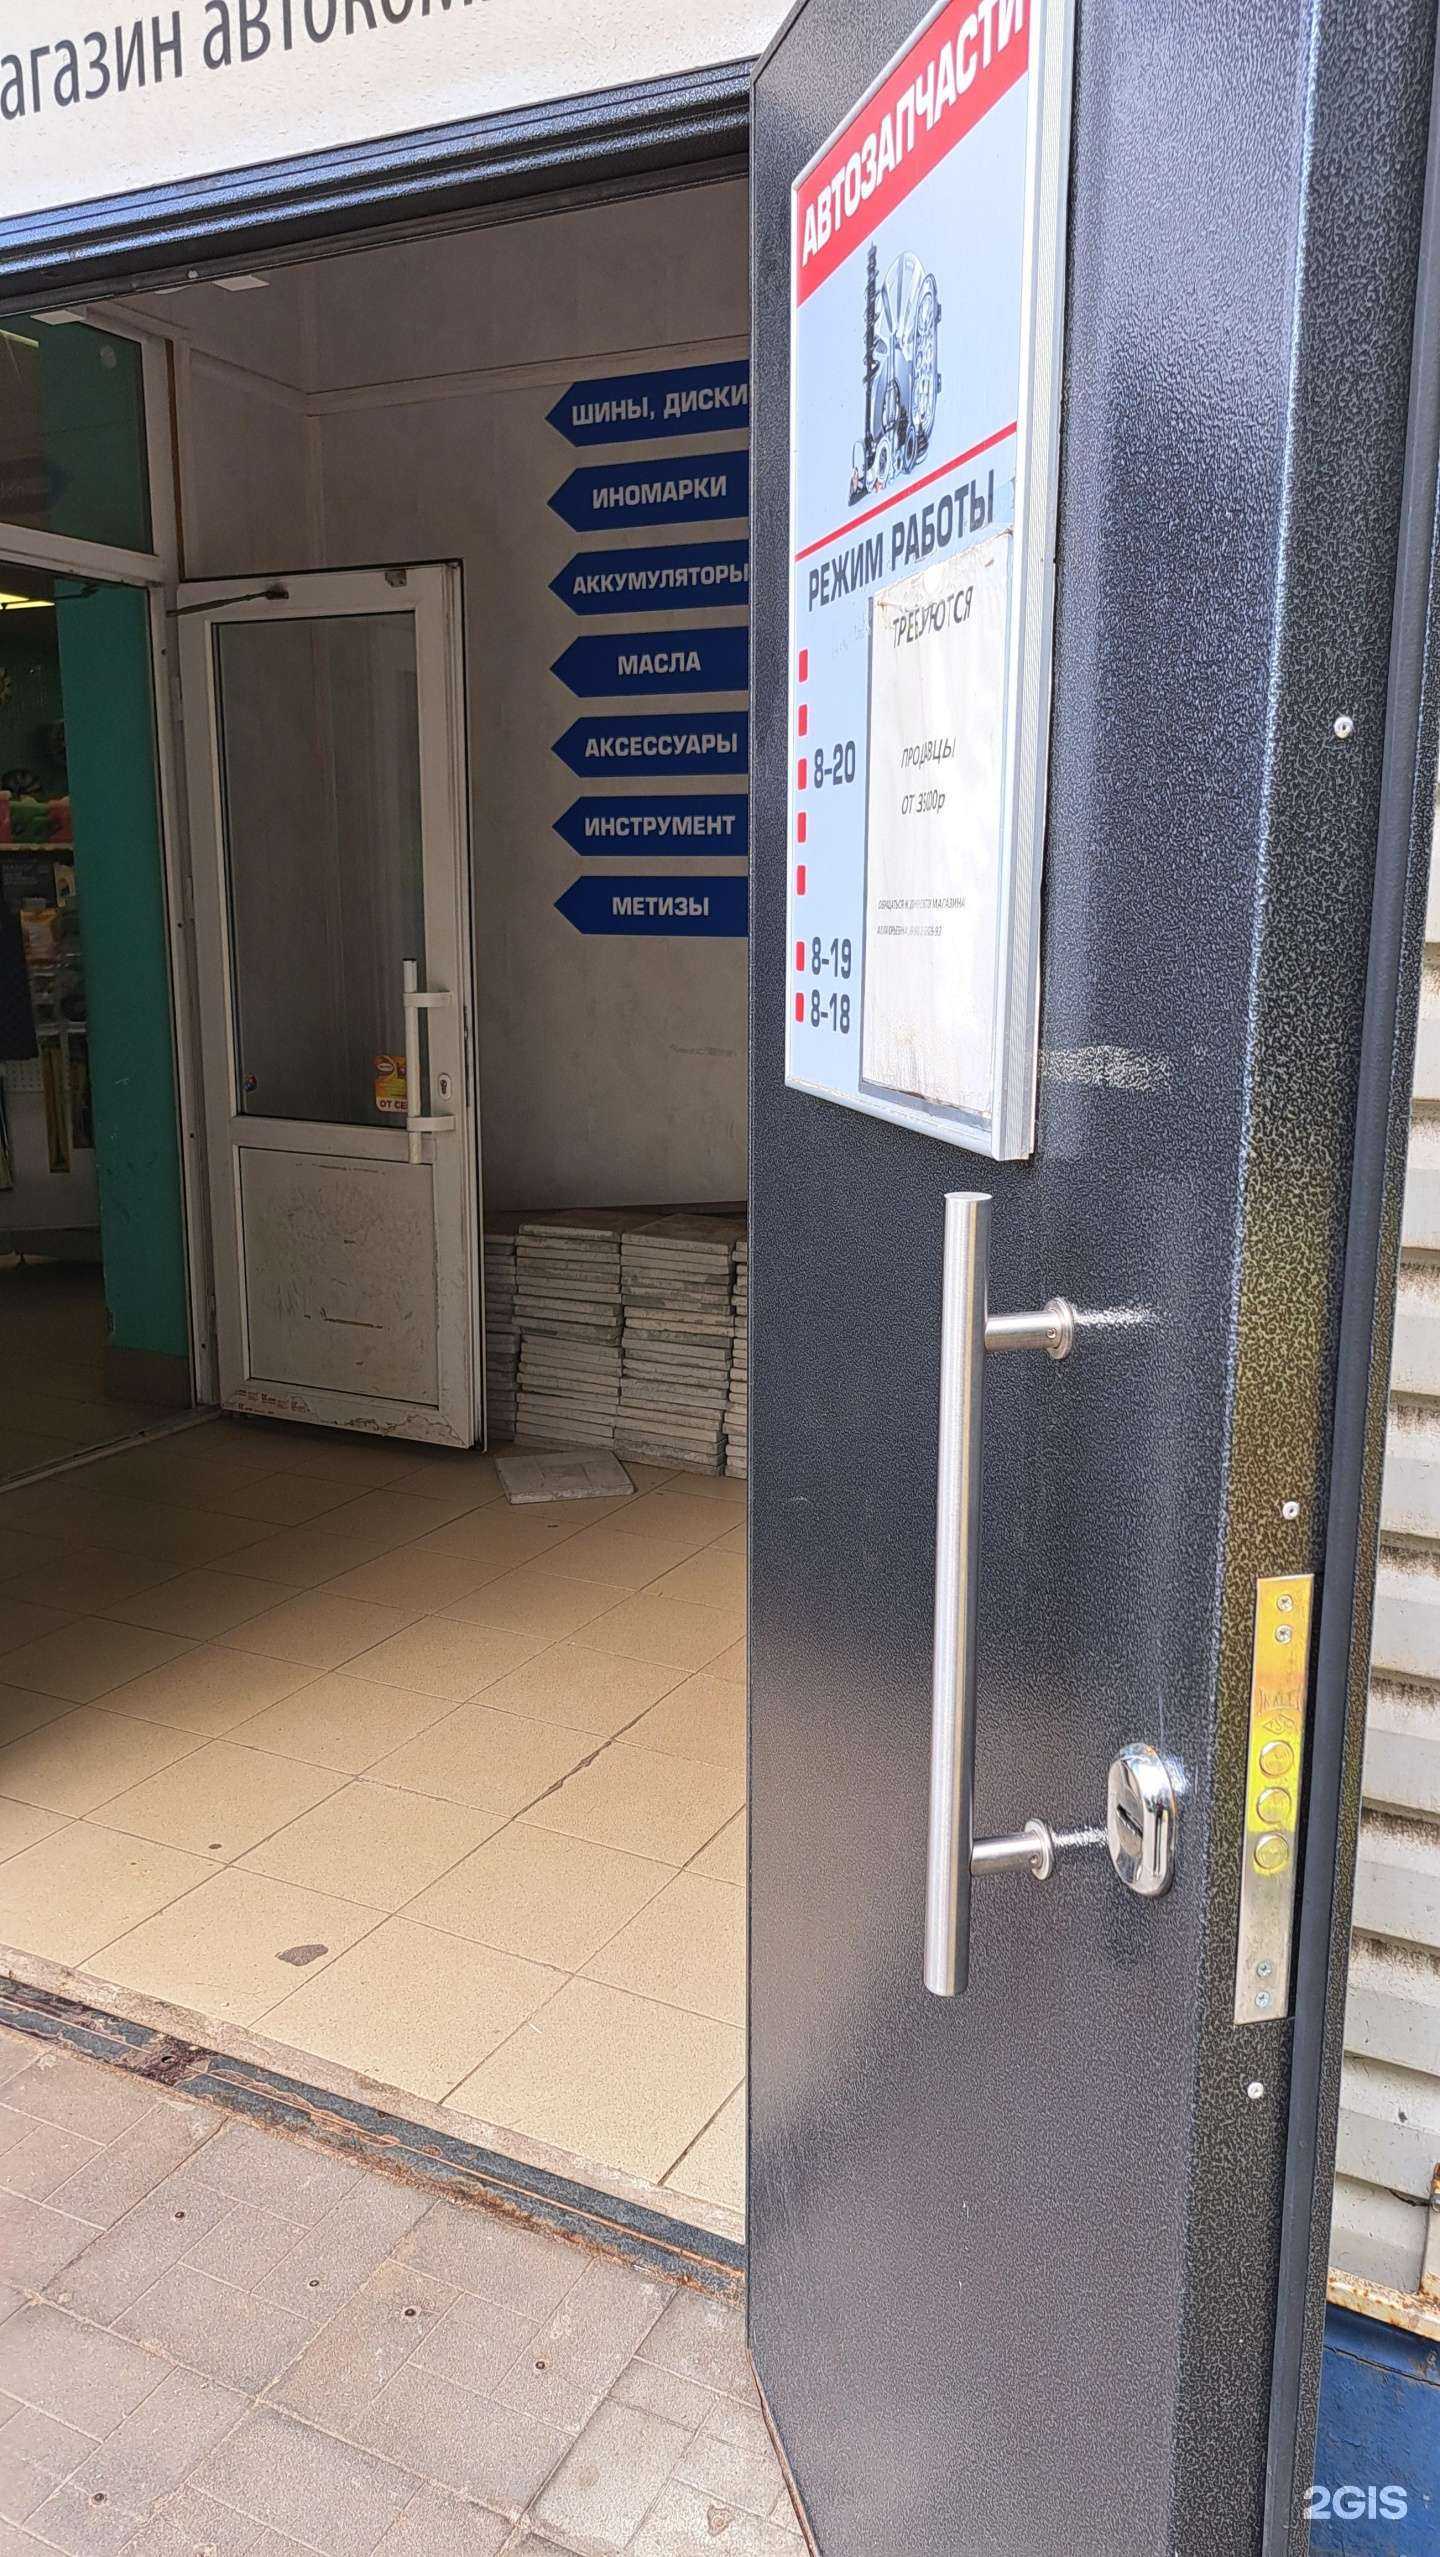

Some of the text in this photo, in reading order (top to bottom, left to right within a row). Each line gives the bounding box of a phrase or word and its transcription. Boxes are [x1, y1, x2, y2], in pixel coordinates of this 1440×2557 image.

[203, 0, 486, 70] авток
[572, 383, 748, 426] ШИНЫ, ДИСКИ
[592, 475, 727, 509] ИНОМАРКИ
[808, 469, 995, 612] РЕЖИМ РАБОТЫ
[572, 563, 748, 595] АККУМУЛЯТОРЫ
[617, 651, 701, 676] МАСЛА
[584, 733, 738, 758] АКСЕССУАРЫ
[813, 740, 856, 789] 8-20
[901, 794, 915, 815] ОТ
[584, 815, 736, 837] ИНСТРУМЕНТ
[612, 897, 709, 916] МЕТИЗЫ
[811, 936, 852, 980] 8-19
[810, 989, 851, 1034] 8-18
